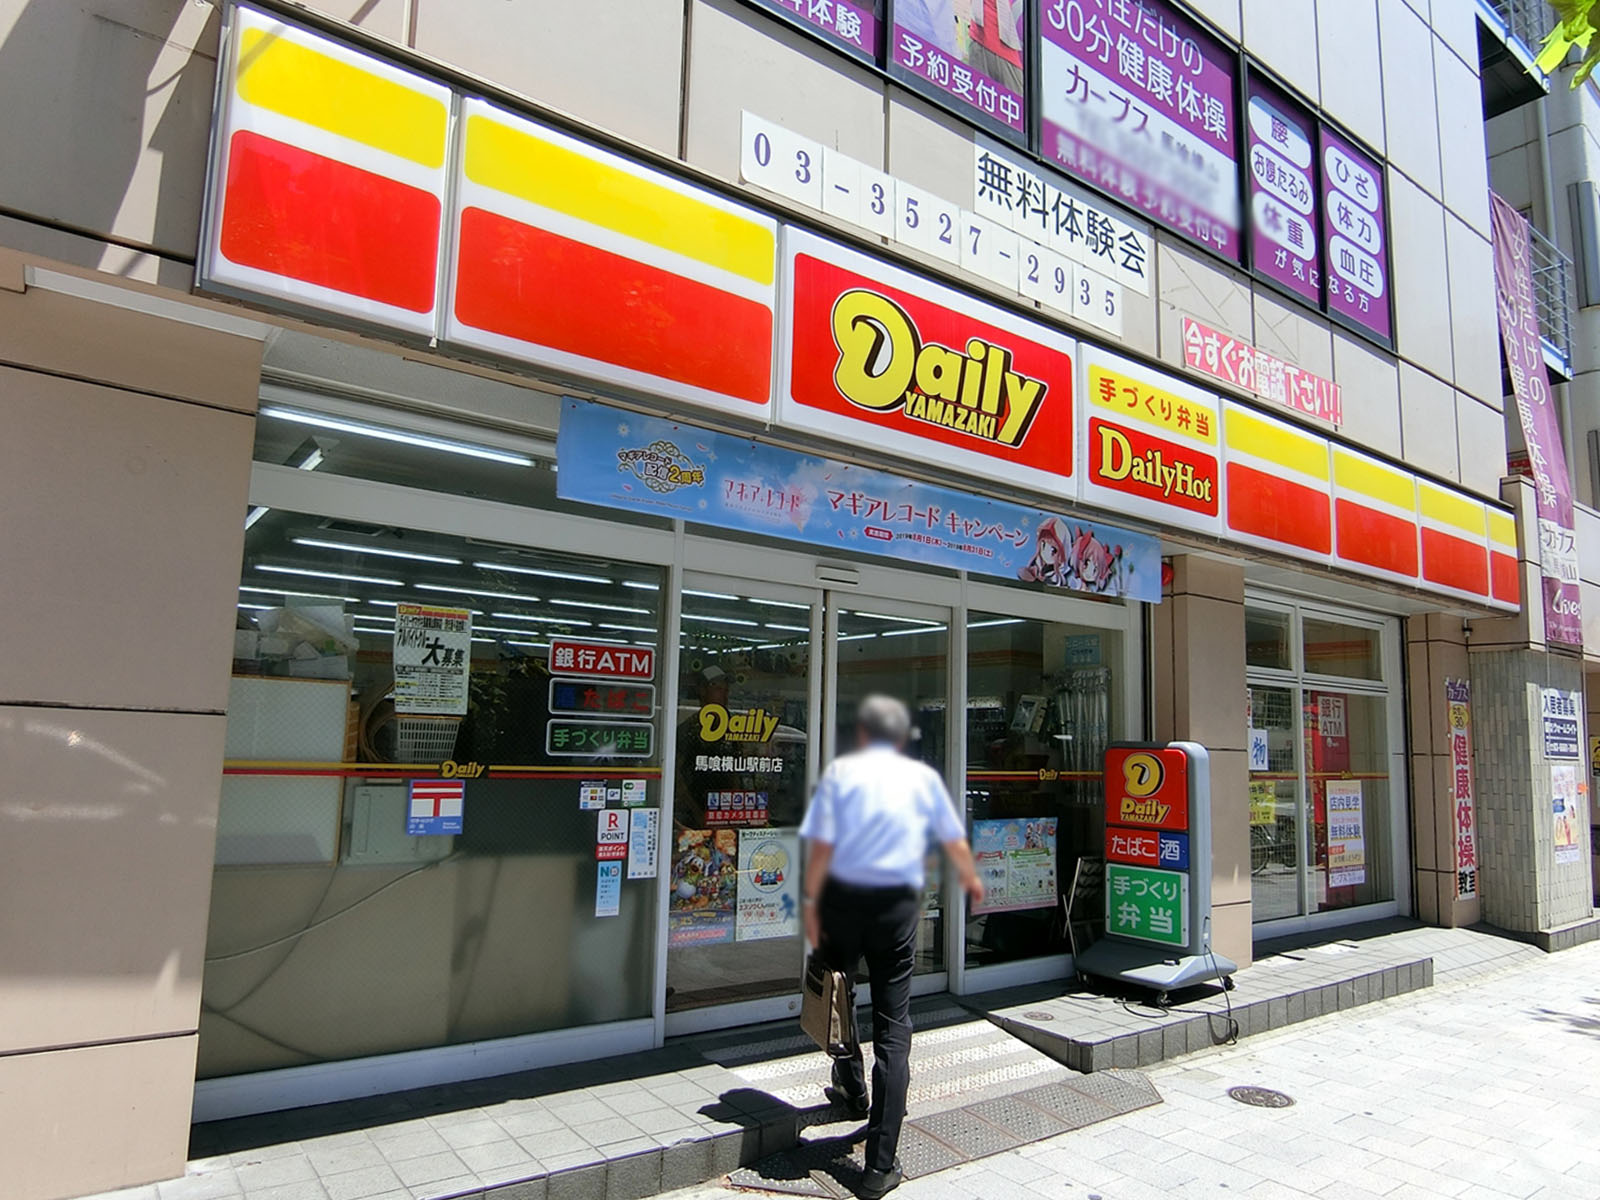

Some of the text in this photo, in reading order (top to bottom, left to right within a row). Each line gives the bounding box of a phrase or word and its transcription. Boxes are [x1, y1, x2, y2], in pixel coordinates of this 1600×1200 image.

[782, 0, 862, 45] 体験
[1095, 0, 1203, 75] 性だけの
[900, 33, 1020, 124] 予約受付中
[1047, 0, 1228, 143] 30分健康体操
[1254, 151, 1309, 206] お腹たるみ
[1335, 156, 1369, 200] ひざ
[754, 132, 1116, 317] 03-3527-2935
[978, 150, 1147, 279] 無料体験会
[1263, 202, 1305, 250] 体重
[1336, 201, 1372, 244] 体力
[1340, 248, 1375, 288] 血圧
[831, 288, 1048, 449] Daily
[903, 389, 998, 442] YAMAZAKI
[1098, 377, 1210, 437] 手づくり弁当
[1098, 426, 1212, 503] DailyHot
[828, 488, 941, 529] マギアレコード
[944, 511, 1030, 549] キャンペーン
[554, 647, 650, 674] 銀行ATM
[583, 688, 649, 711] たばこ
[1321, 700, 1342, 717] 銀行
[553, 728, 648, 749] 手づくり弁当
[699, 703, 780, 742] Daily
[725, 733, 761, 742] YAMAZAKI
[1322, 720, 1344, 736] ATM
[441, 760, 485, 779] Daily
[695, 755, 783, 773] 馬喰横山駅前店
[1119, 797, 1170, 824] Daily
[1120, 813, 1156, 823] YAMAZAKI
[1453, 734, 1475, 868] 健康体操
[601, 832, 625, 841] POINT
[1112, 834, 1157, 858] たばこ
[1159, 838, 1181, 862] 酒
[1113, 875, 1178, 902] 手づくり
[1117, 901, 1174, 935] 弁当
